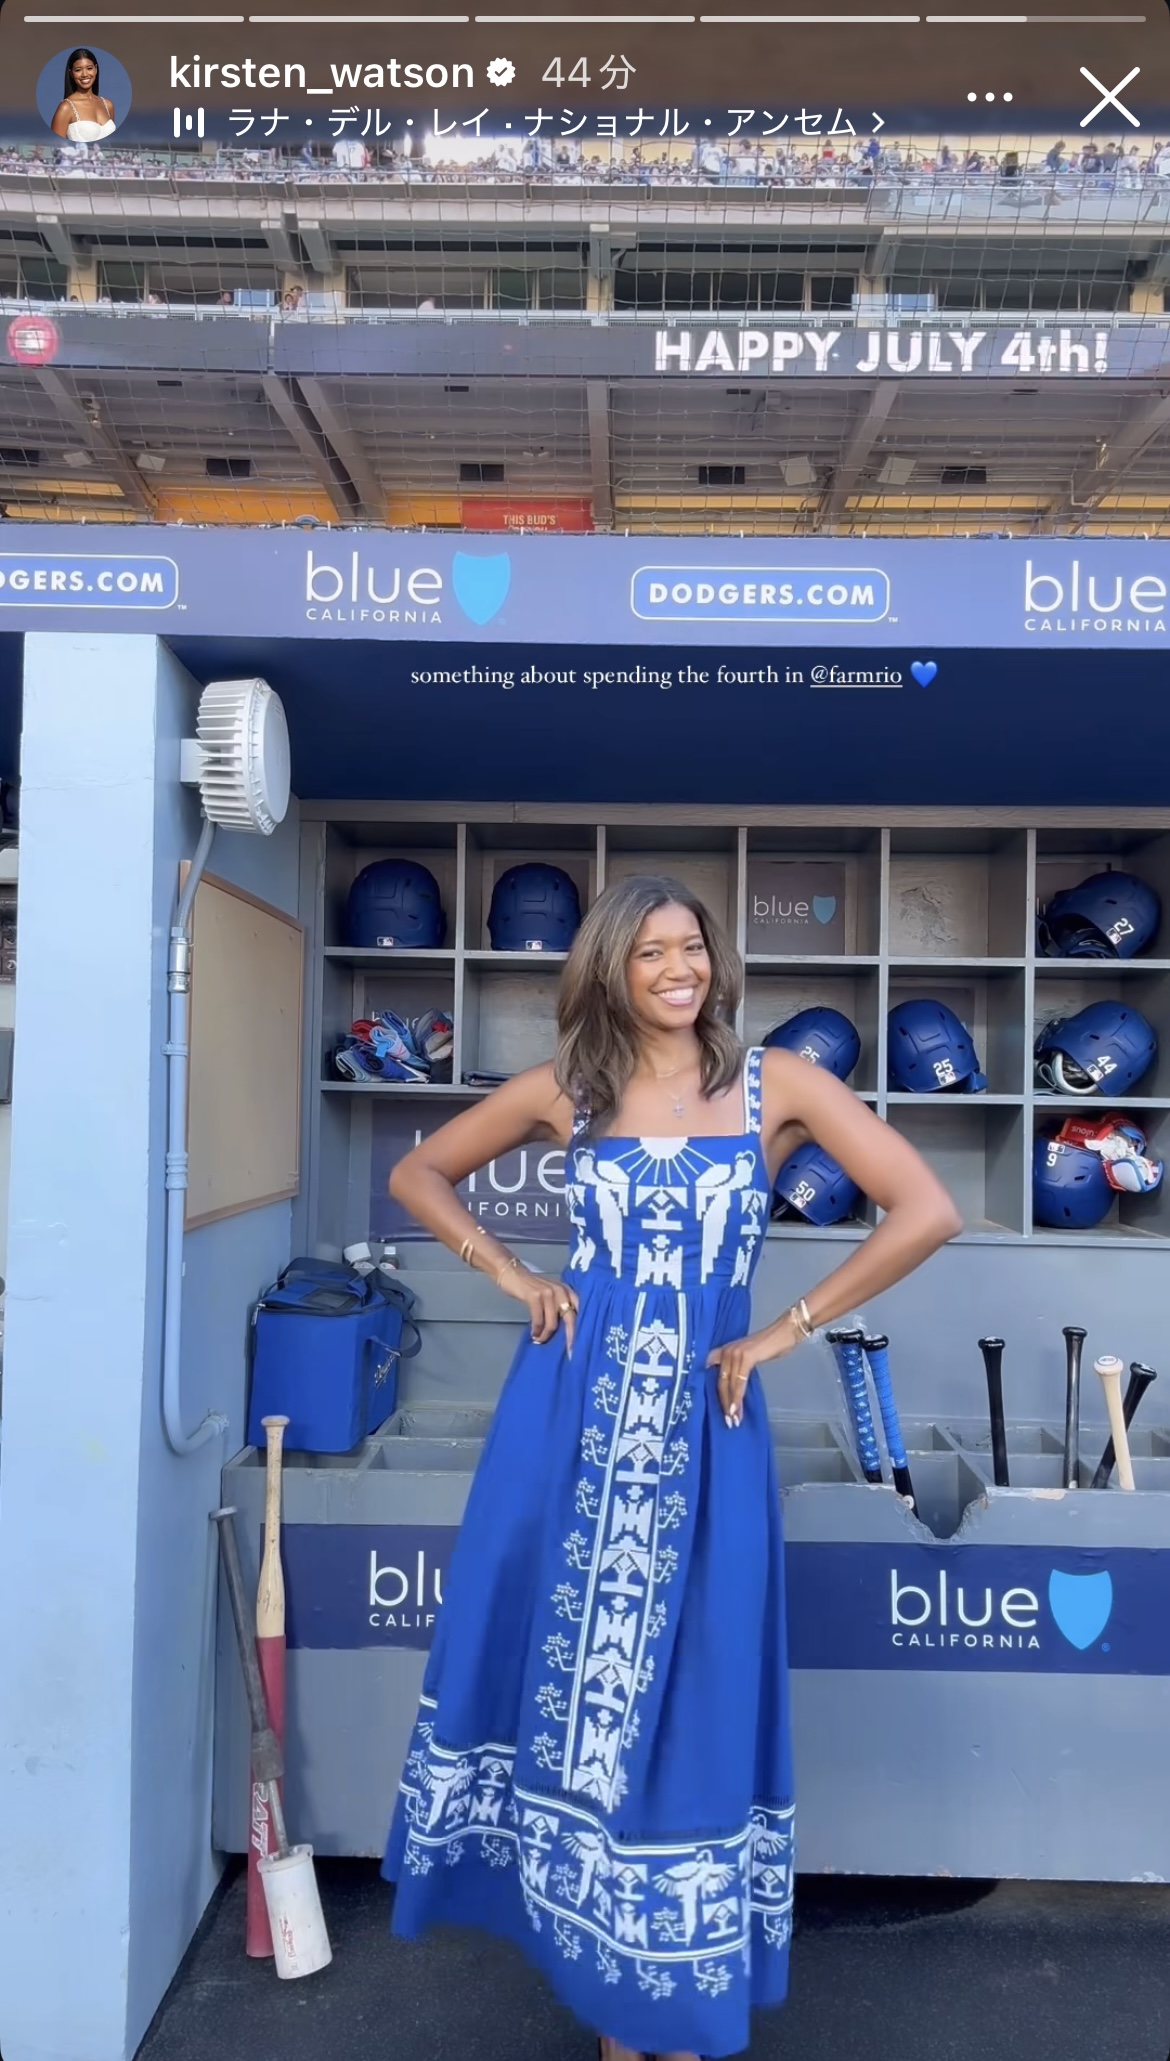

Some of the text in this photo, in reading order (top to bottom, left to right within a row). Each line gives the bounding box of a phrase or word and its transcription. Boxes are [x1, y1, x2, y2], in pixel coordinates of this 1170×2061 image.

[655, 329, 1108, 374] HAPPY JULY 4th!
[503, 514, 556, 525] THIS BUD'S
[306, 550, 443, 605] blue
[1025, 560, 1167, 613] blue
[649, 582, 875, 607] DODGERS.COM
[306, 608, 443, 624] CALIFORNIA
[1024, 618, 1167, 632] CALIFORNIA
[754, 895, 809, 917] blue
[753, 917, 809, 925] CALIFORNIA
[1113, 917, 1135, 936] 27
[799, 1046, 821, 1065] 25
[1096, 1055, 1118, 1075] 44
[933, 1058, 954, 1077] 25
[1046, 1153, 1058, 1167] 9
[795, 1180, 816, 1202] 50
[369, 1550, 443, 1606] bl
[892, 1569, 1039, 1627] blue
[369, 1613, 436, 1627] CALIF
[892, 1632, 1041, 1649] CALIFORNIA
